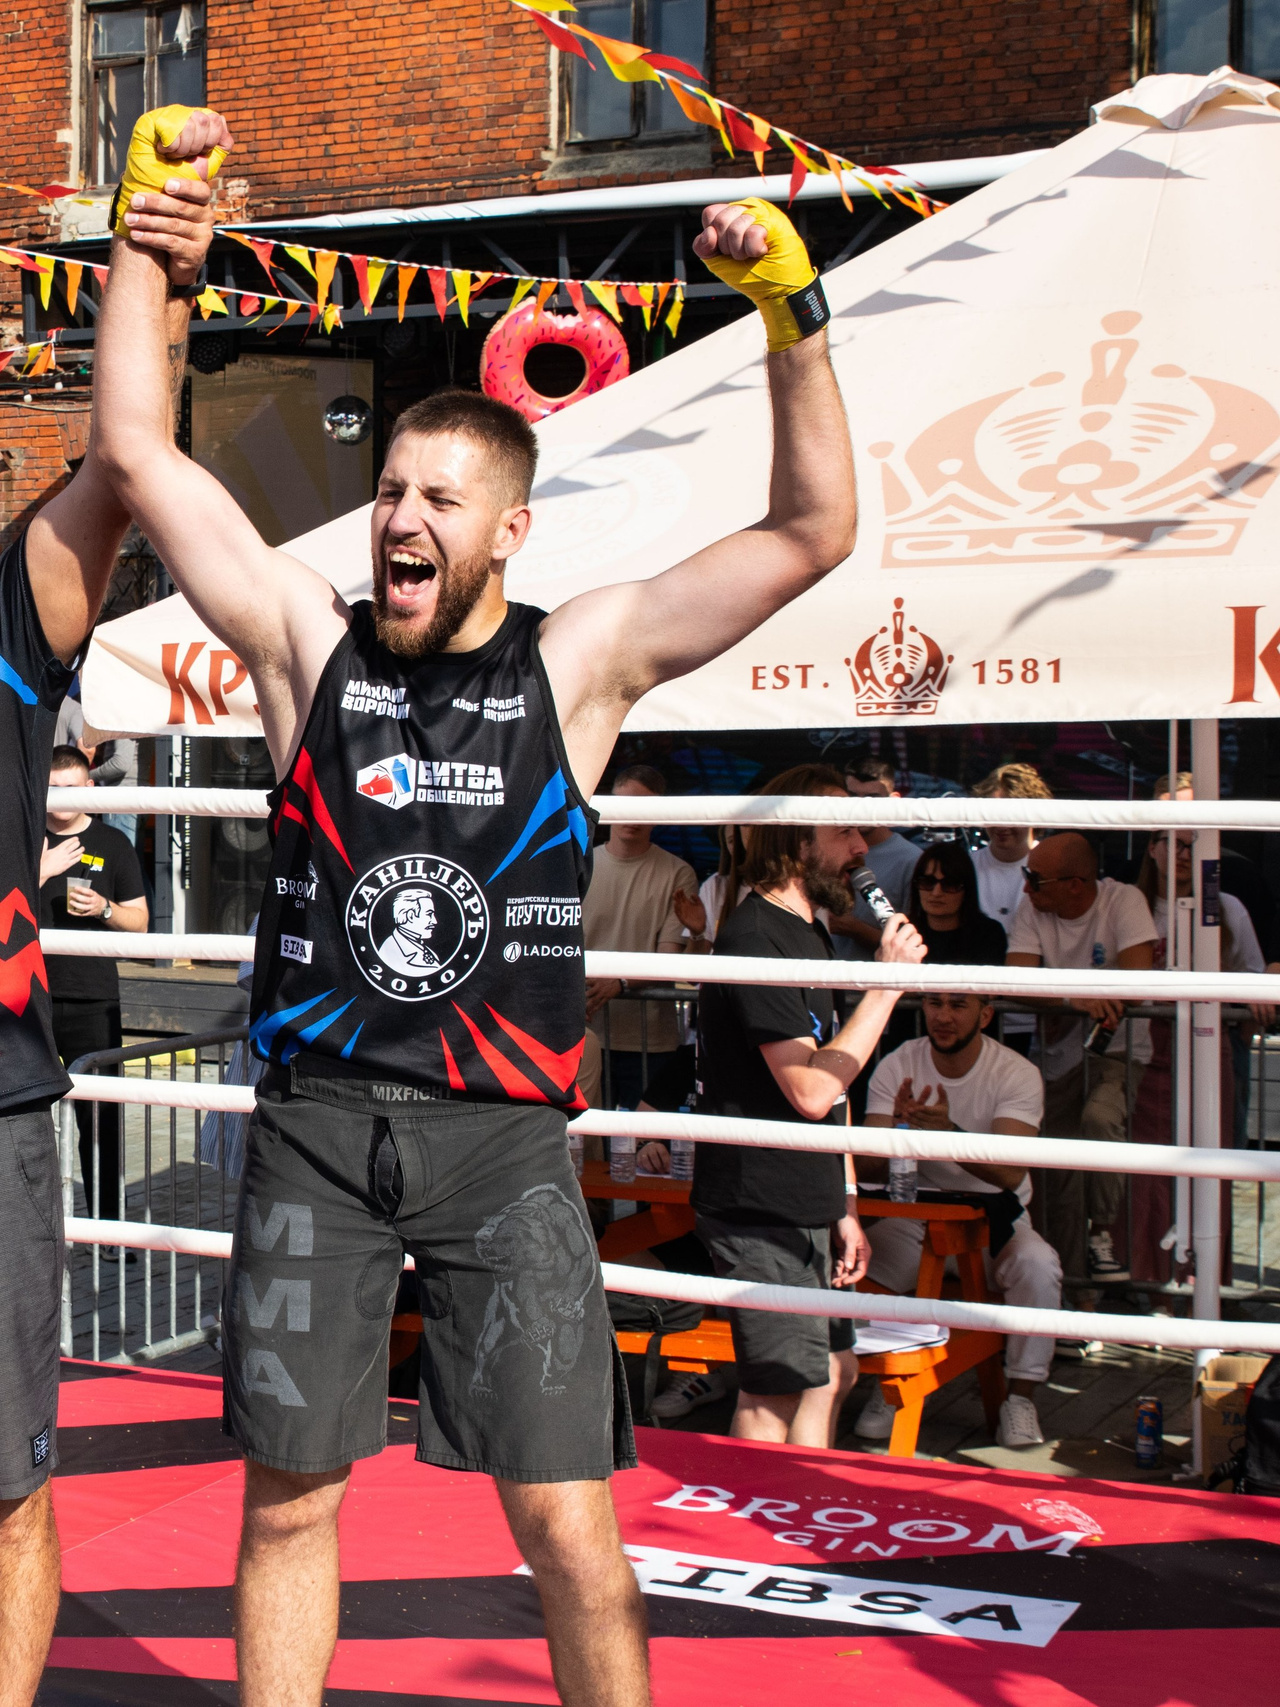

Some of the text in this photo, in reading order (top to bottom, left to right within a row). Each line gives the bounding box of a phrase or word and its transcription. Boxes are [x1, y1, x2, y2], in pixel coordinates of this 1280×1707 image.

[804, 290, 825, 321] clinch
[161, 641, 262, 726] КР
[751, 657, 1062, 691] EST. 1581
[452, 698, 480, 712] КАФЕ
[417, 760, 505, 791] БИТВА
[350, 859, 485, 939] КАНЦЛЕРЪ
[504, 904, 582, 928] КРУТОЯР
[523, 944, 582, 958] LADOGA
[368, 964, 456, 994] 2010
[372, 1084, 451, 1102] MIXFIGHT
[652, 1484, 1093, 1558] BROOM
[773, 1530, 902, 1558] GIN
[649, 1565, 1023, 1632] IBSA
